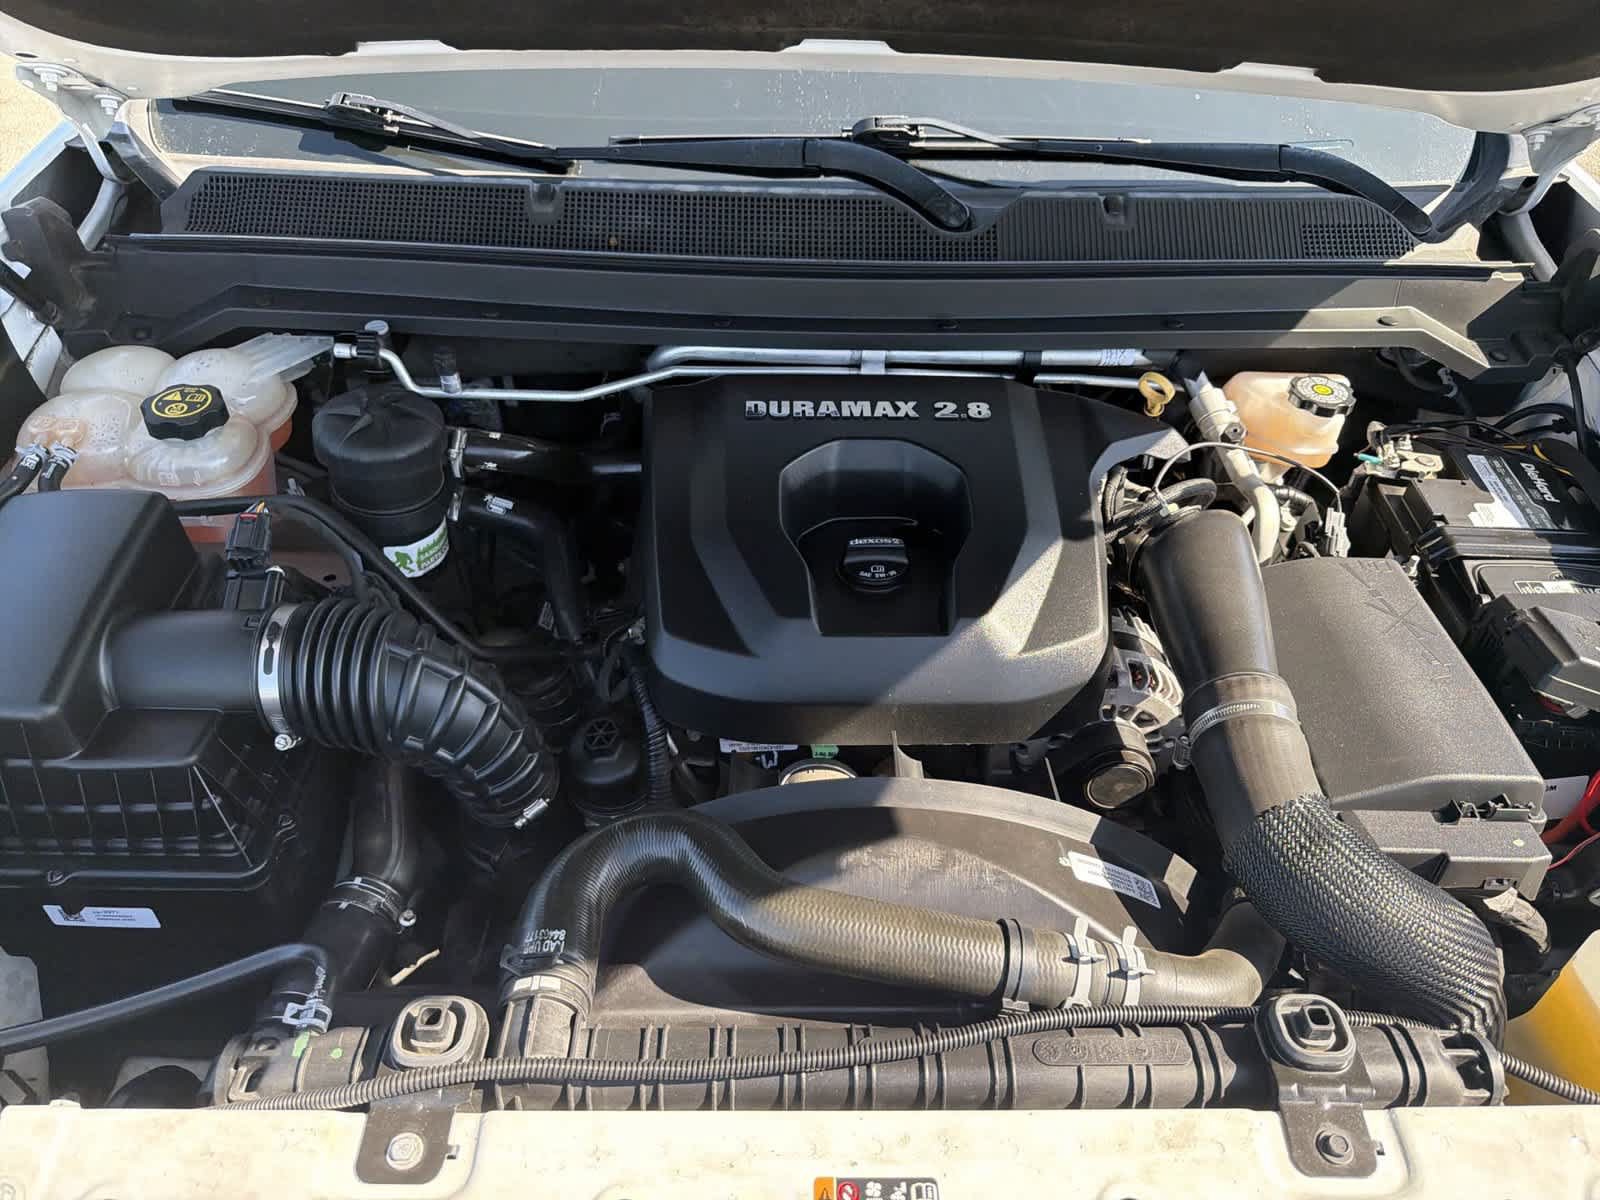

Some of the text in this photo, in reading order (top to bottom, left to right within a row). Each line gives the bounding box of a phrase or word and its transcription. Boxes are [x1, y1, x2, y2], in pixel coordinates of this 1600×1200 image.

[745, 400, 992, 419] DURAMAX 2.8
[1520, 462, 1560, 503] DieHard
